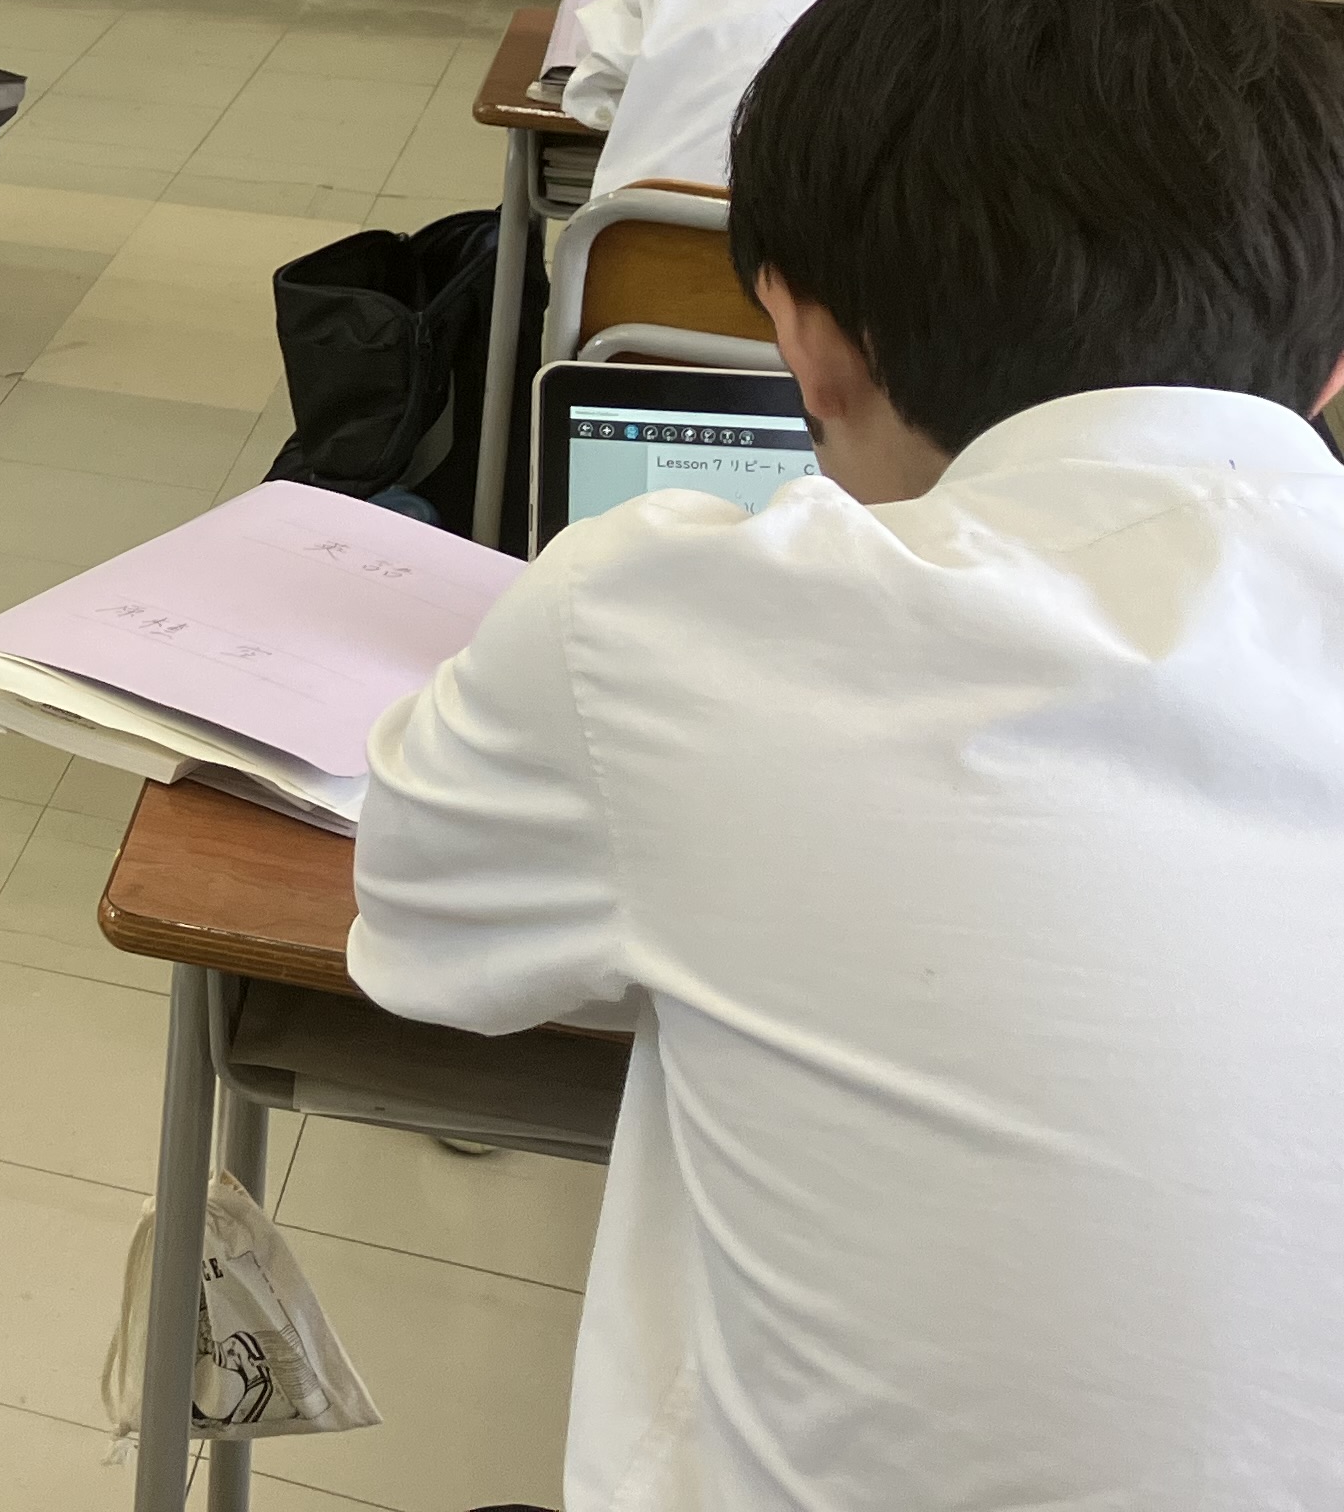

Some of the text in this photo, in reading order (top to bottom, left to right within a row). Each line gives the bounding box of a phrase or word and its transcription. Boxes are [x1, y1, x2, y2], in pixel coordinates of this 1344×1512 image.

[656, 455, 709, 472] Lesson
[712, 458, 723, 472] 7
[730, 460, 787, 475] リピート
